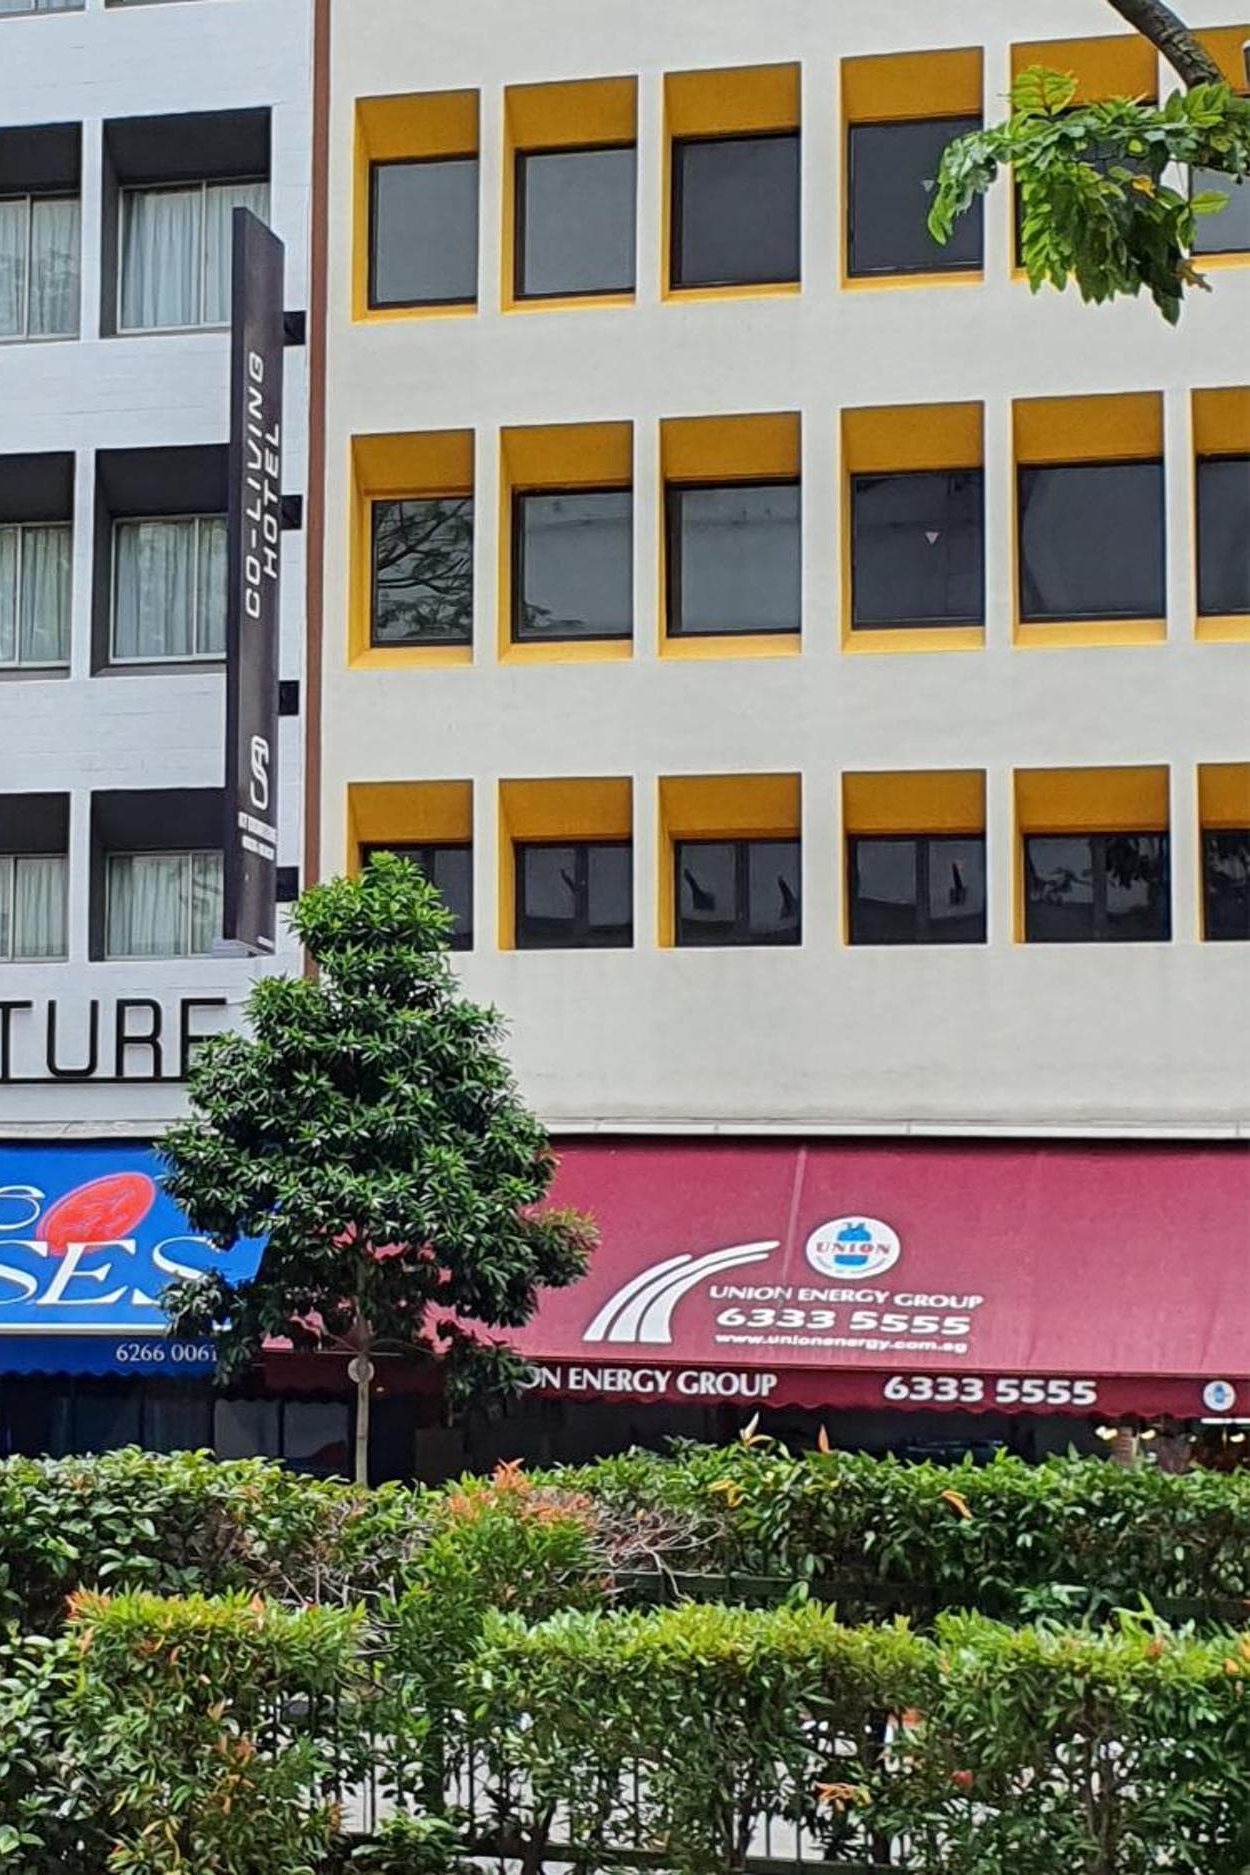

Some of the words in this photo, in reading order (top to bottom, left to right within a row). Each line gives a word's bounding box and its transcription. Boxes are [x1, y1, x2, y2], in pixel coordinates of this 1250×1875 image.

[245, 351, 265, 619] CO-LIVING
[263, 423, 280, 579] HOTEL
[816, 1241, 891, 1254] UNION
[709, 1285, 792, 1301] UNION
[798, 1287, 890, 1305] ENERGY
[893, 1292, 985, 1310] GROUP
[716, 1307, 836, 1330] 6333
[849, 1310, 971, 1336] 5555
[115, 1344, 165, 1362] 6266
[714, 1333, 969, 1354] www.unionenergy.com.sg
[568, 1367, 671, 1394] ENERGY
[676, 1370, 778, 1397] GROUP
[883, 1376, 984, 1401] 6333
[995, 1379, 1098, 1405] 5555
